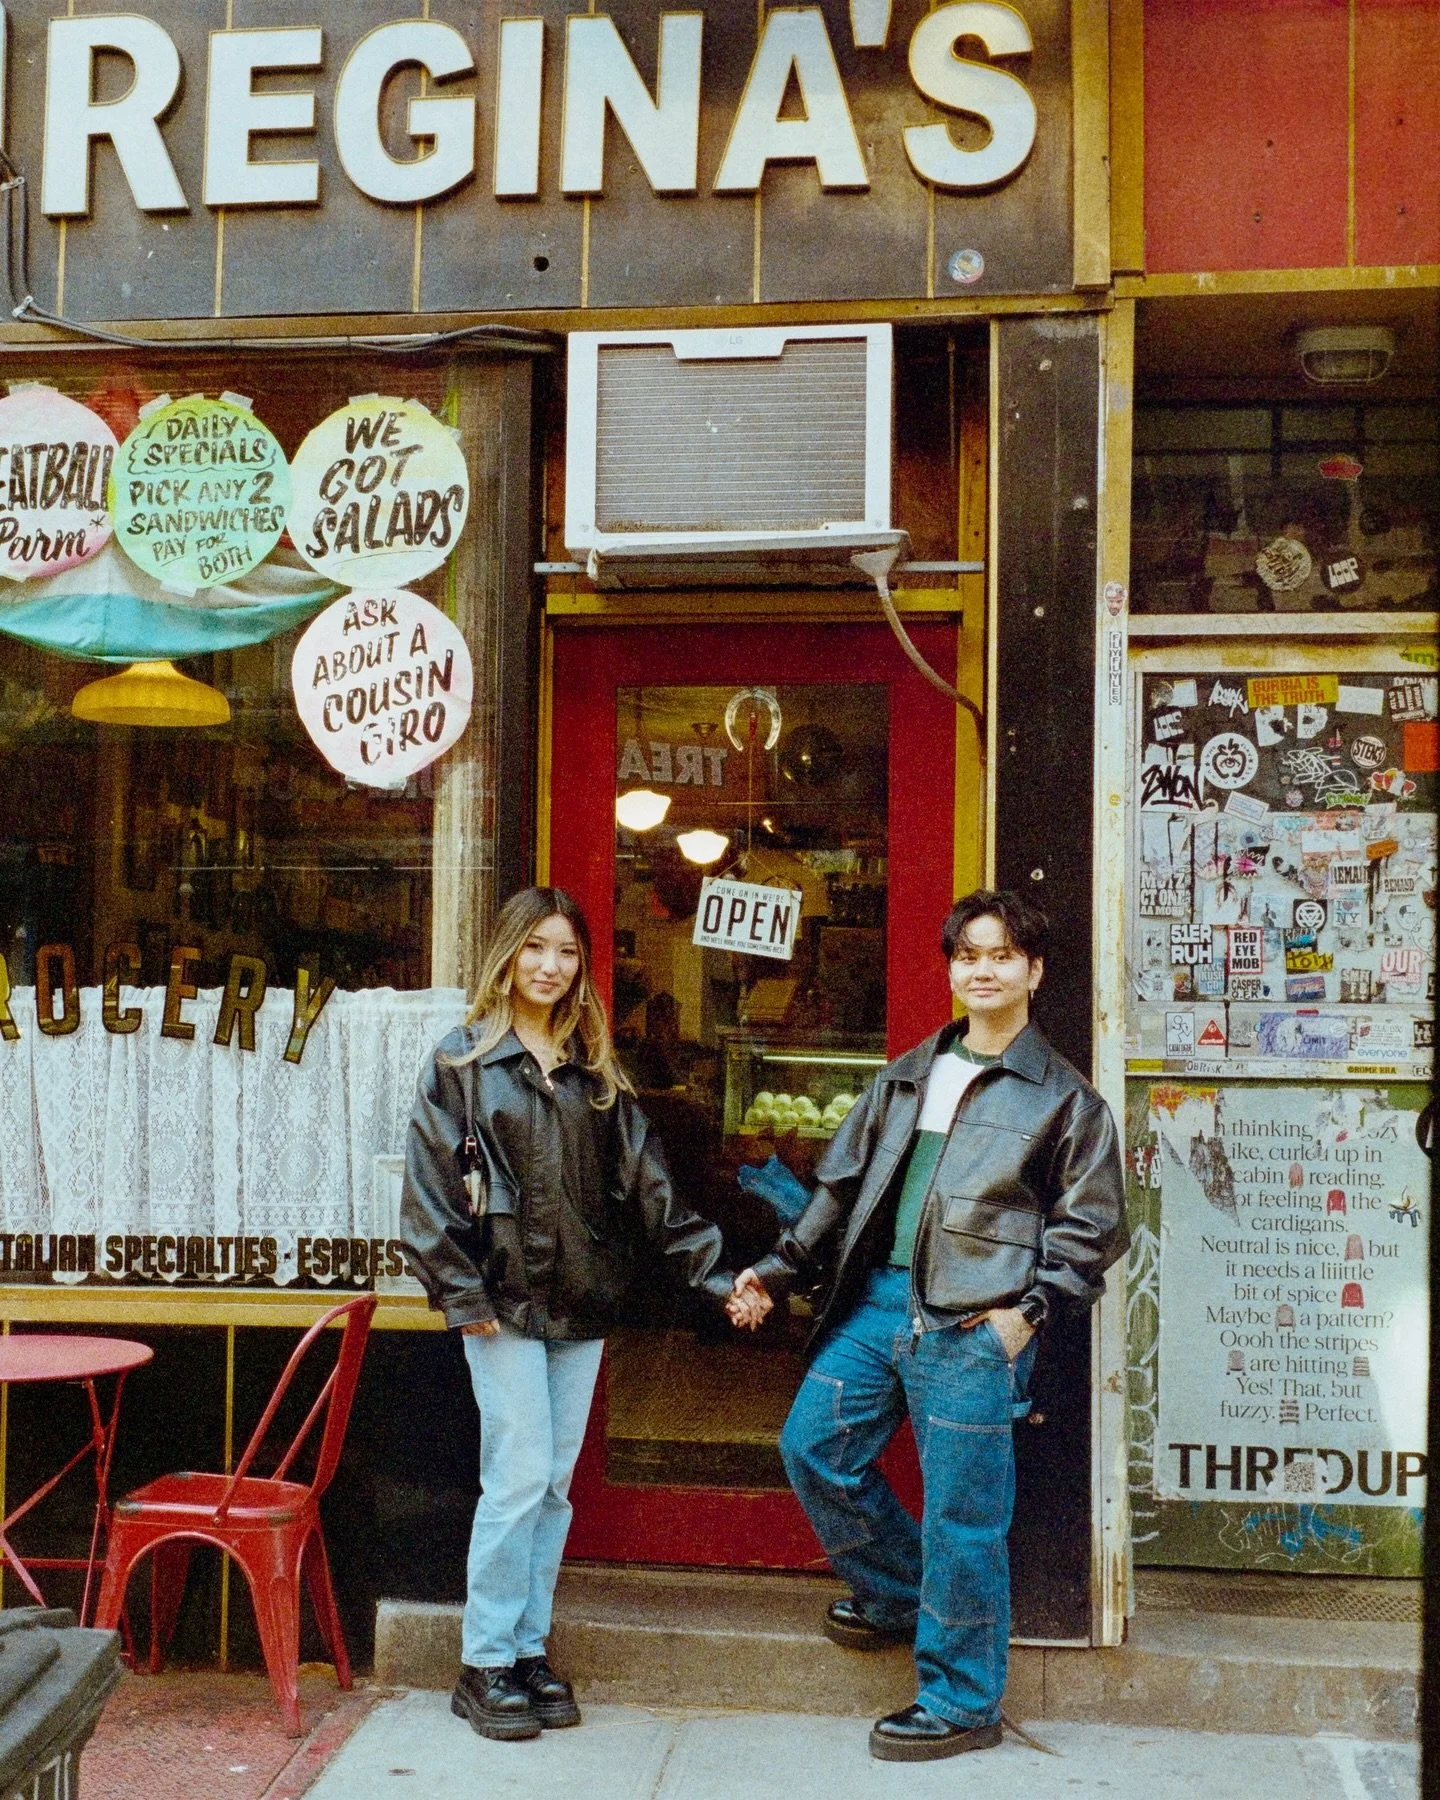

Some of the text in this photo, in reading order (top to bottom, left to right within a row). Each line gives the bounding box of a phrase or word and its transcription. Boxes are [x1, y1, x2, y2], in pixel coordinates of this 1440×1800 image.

[42, 0, 1037, 216] REGINA'S
[166, 413, 239, 442] DAILY
[345, 410, 407, 454] WE
[144, 438, 269, 466] SPECIALS
[318, 443, 424, 506] GOT
[129, 471, 275, 506] PICK ANY 2
[126, 504, 285, 536] SANDWICHES
[305, 483, 465, 559] SALADS
[152, 532, 228, 562] PAY FOR
[197, 546, 254, 580] BOTH
[342, 597, 399, 637] ASK
[311, 622, 428, 690] ABOUT A
[322, 648, 454, 733] COUSIN
[1306, 675, 1320, 689] IS
[1253, 689, 1325, 706] THE TRUTH
[716, 886, 736, 897] COME
[738, 889, 749, 898] ON
[751, 892, 760, 900] IN
[702, 894, 791, 945] OPEN
[1233, 931, 1258, 944] RED
[1171, 944, 1213, 964] RUH
[1235, 944, 1257, 957] EYE
[1382, 950, 1422, 974] OUR
[1231, 957, 1260, 970] MOB
[1230, 978, 1262, 992] CASPER
[1357, 1048, 1408, 1058] everyone
[1232, 1119, 1314, 1142] thinking
[1227, 1143, 1265, 1162] ike,
[1335, 1149, 1358, 1164] up
[1364, 1145, 1383, 1162] in
[1234, 1168, 1386, 1190] cabin reading.
[1258, 1192, 1323, 1212] feeling
[1351, 1193, 1382, 1209] the
[1251, 1215, 1349, 1234] cardigans.
[0, 1233, 96, 1273] TALIAN
[105, 1234, 278, 1276] SPECIALTIES
[1201, 1235, 1400, 1258] Neutral is nice, but
[1225, 1260, 1238, 1277] it
[1242, 1260, 1300, 1279] needs
[1304, 1266, 1316, 1279] a
[1234, 1283, 1337, 1310] bit of spice
[1206, 1306, 1394, 1331] Maybe a pattern?
[1220, 1330, 1379, 1355] Oooh the stripes
[1250, 1356, 1348, 1378] are hitting
[1236, 1376, 1362, 1400] Yes! That, but
[1220, 1400, 1378, 1423] fuzzy. Perfect.
